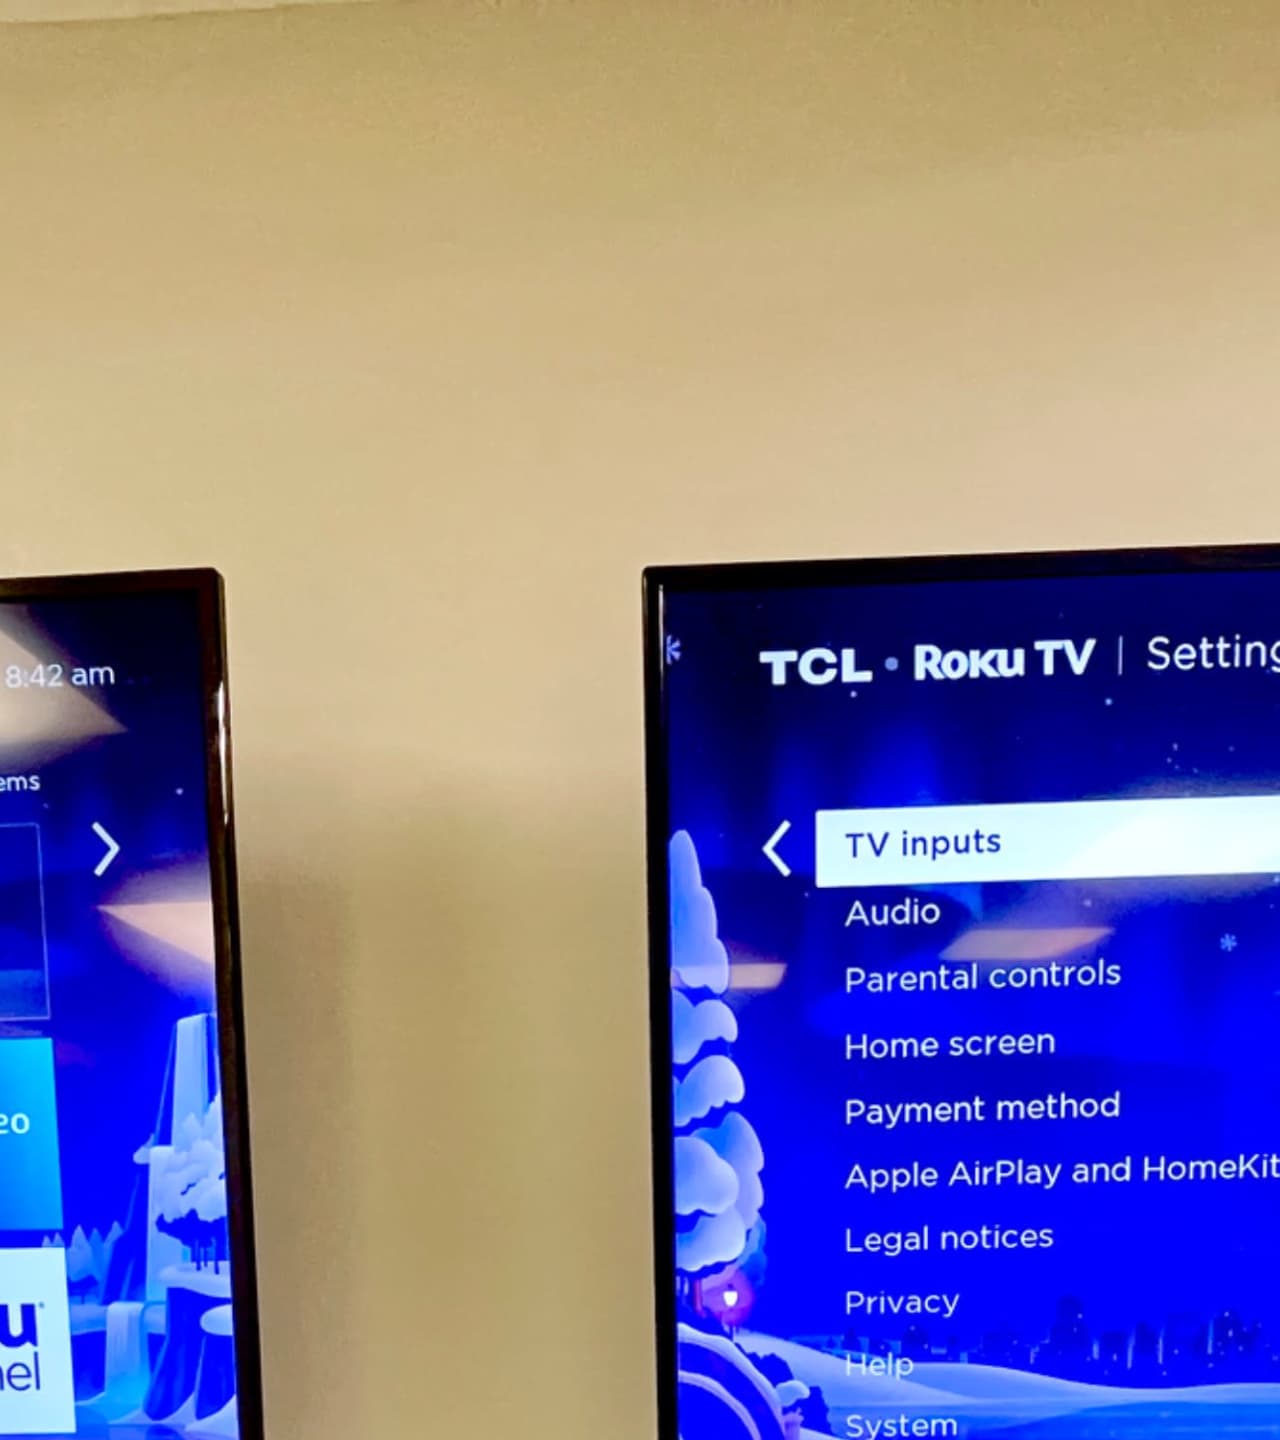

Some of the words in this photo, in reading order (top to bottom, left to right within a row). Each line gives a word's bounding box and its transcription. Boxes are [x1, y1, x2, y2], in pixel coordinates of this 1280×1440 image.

[4, 662, 64, 690] 8:42
[71, 665, 115, 687] am
[760, 647, 873, 687] TCL
[914, 644, 1025, 681] Roku
[1034, 639, 1097, 676] TV
[846, 832, 889, 858] TV
[901, 830, 1002, 859] inputs
[845, 898, 940, 927] Audio
[846, 964, 978, 994] Parental
[988, 958, 1121, 988] controls
[846, 1033, 938, 1060] Home
[949, 1030, 1056, 1057] screen
[846, 1097, 984, 1129] Payment
[995, 1092, 1121, 1120] method
[845, 1162, 938, 1193] Apple
[948, 1158, 1060, 1189] AirPlay
[1072, 1156, 1131, 1184] and
[846, 1225, 929, 1257] Legal
[941, 1223, 1054, 1251] notices
[846, 1289, 959, 1318] Privacy
[846, 1353, 914, 1380] Help
[846, 1412, 958, 1440] System
